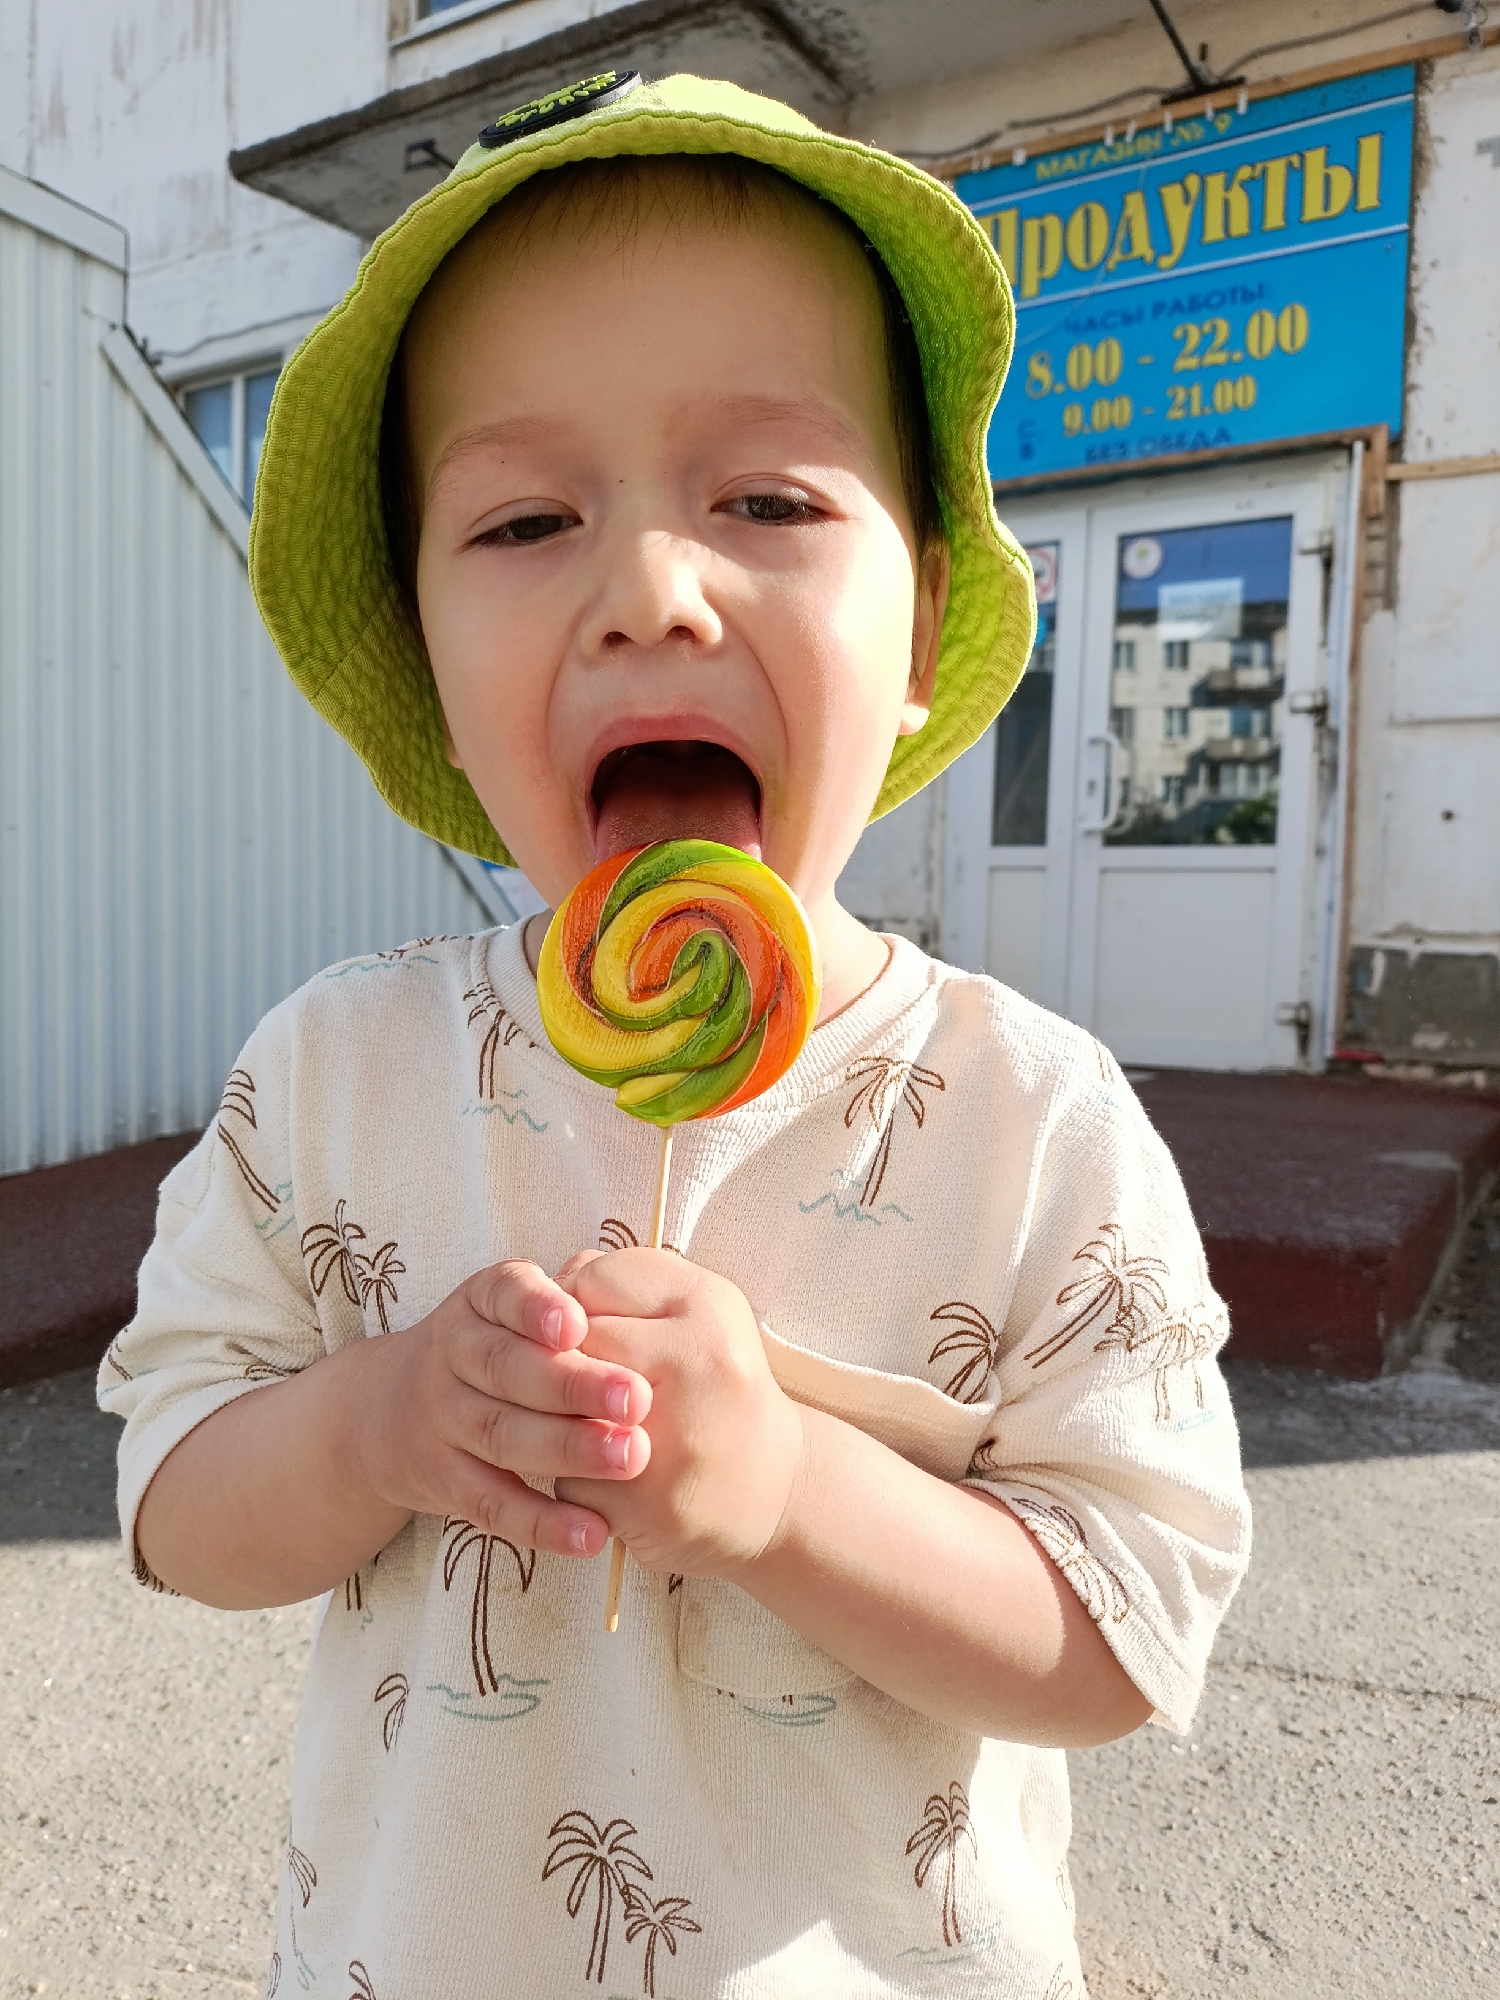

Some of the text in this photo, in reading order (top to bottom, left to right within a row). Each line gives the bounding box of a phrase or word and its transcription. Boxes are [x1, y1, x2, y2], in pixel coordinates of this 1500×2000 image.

[1035, 131, 1163, 180] МАГАЗИН
[1213, 113, 1232, 135] 9
[1024, 337, 1123, 400] 8.00
[1172, 301, 1310, 373] 22.00
[1063, 304, 1146, 335] ЧАСЫ
[1062, 393, 1133, 438] 9.00
[1165, 373, 1257, 421] 21.00
